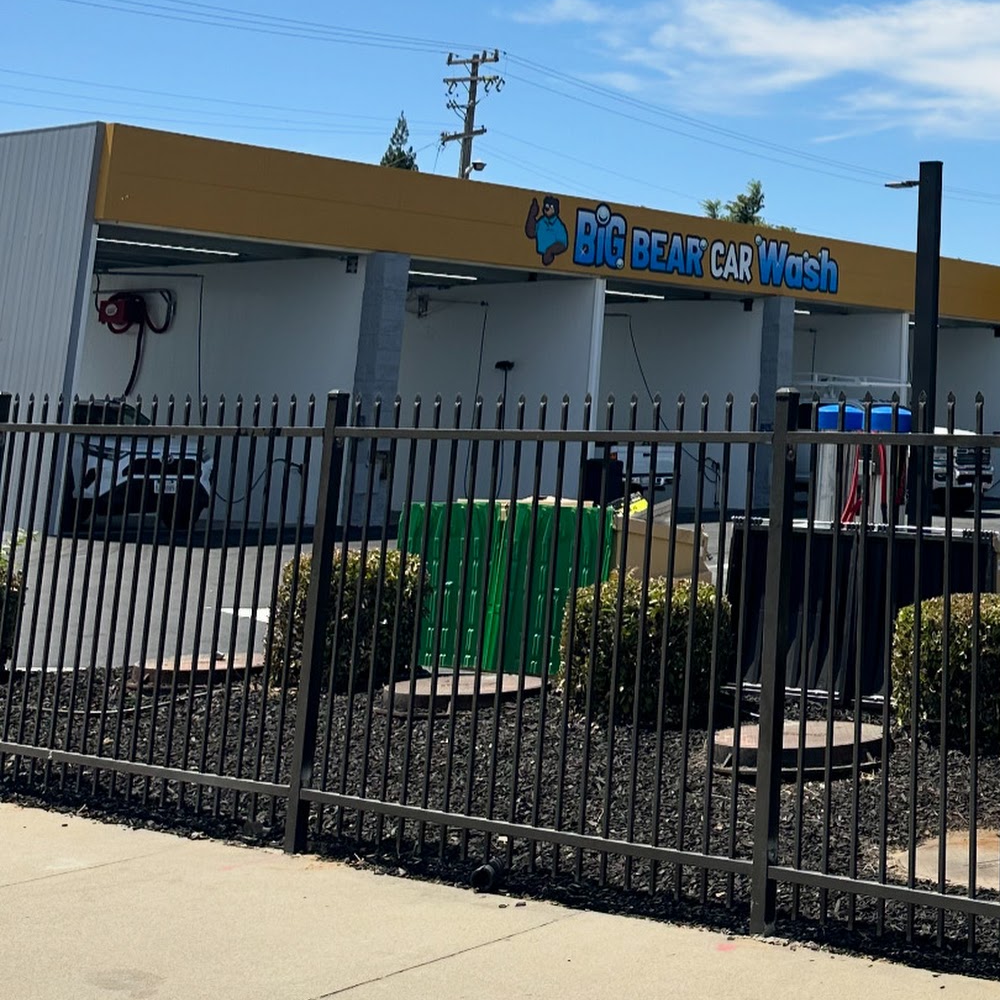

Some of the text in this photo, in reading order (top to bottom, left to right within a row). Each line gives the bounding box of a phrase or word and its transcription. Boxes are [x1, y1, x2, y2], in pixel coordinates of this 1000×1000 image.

[632, 230, 704, 277] BEAR
[710, 243, 752, 283] CAR
[758, 239, 839, 293] Wash
